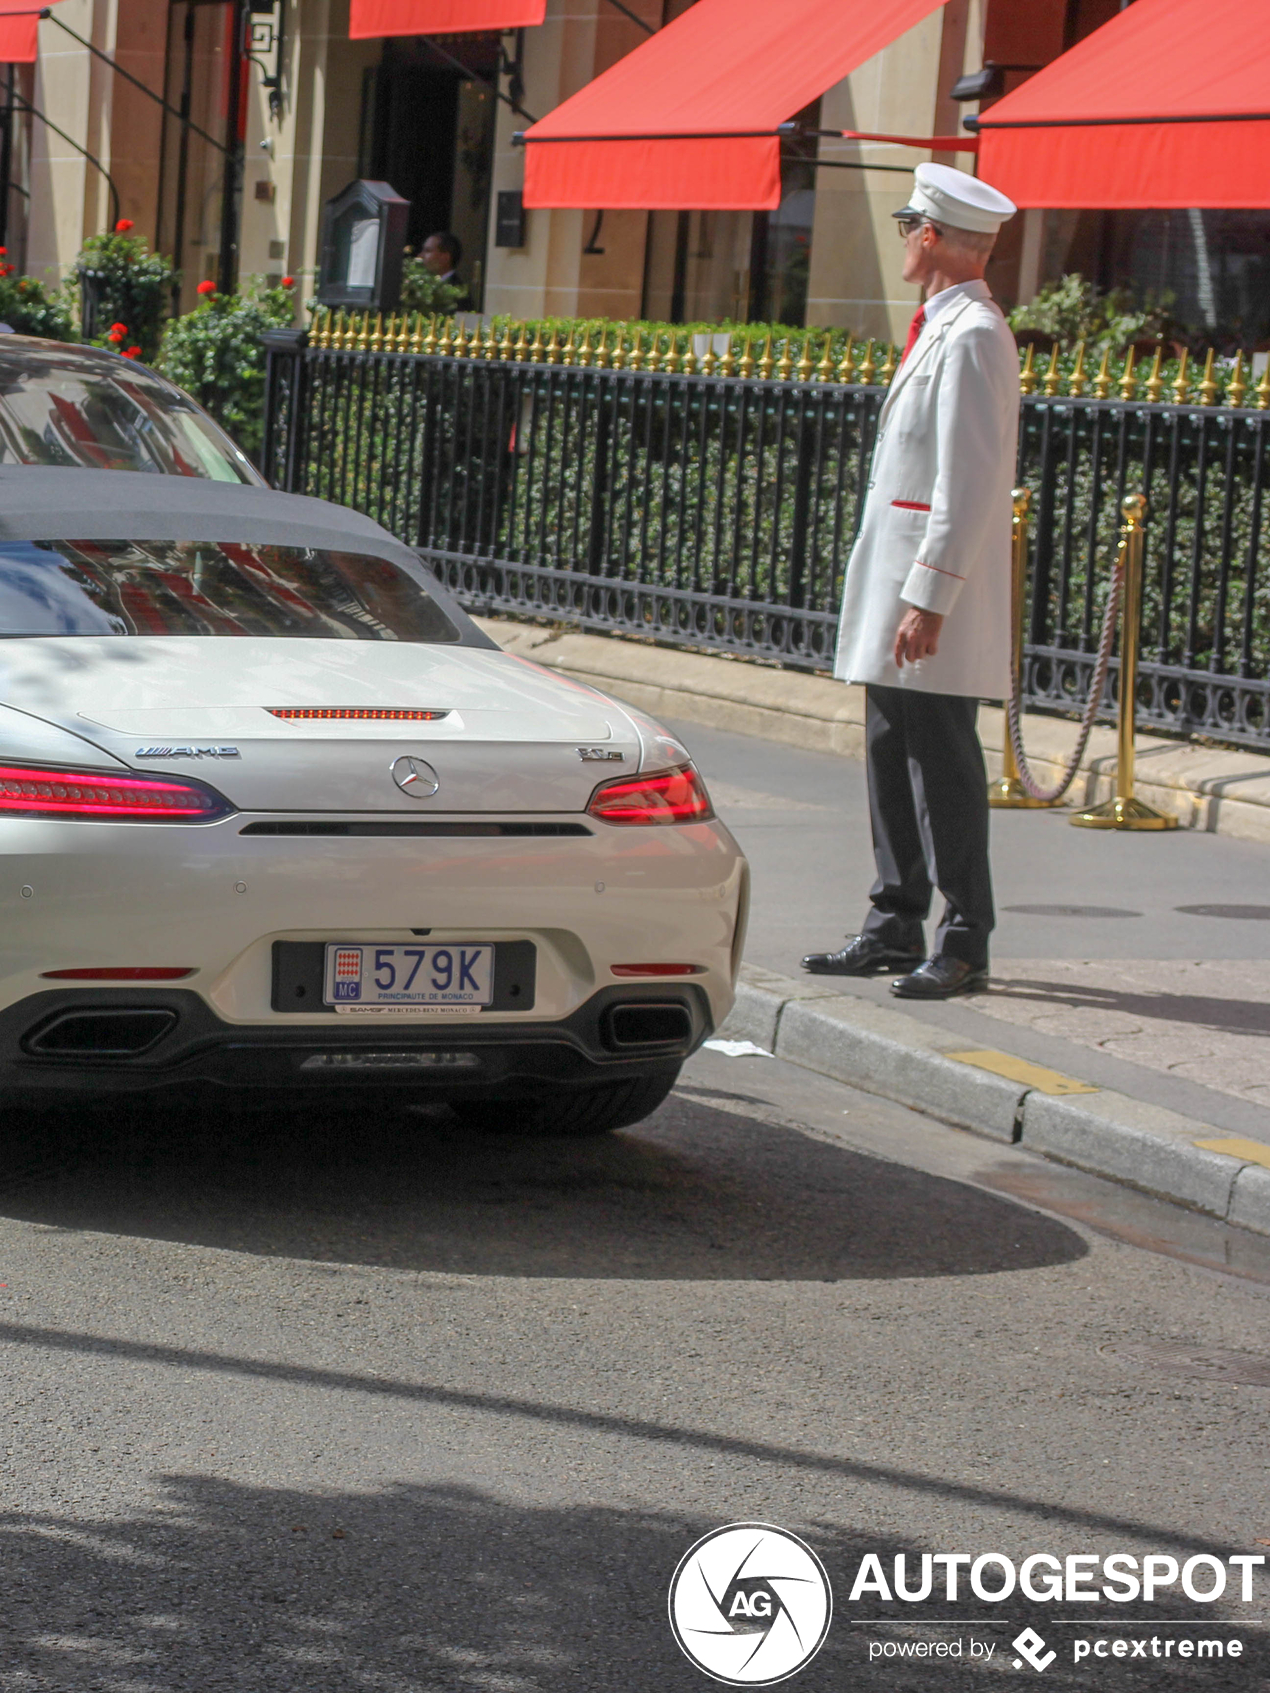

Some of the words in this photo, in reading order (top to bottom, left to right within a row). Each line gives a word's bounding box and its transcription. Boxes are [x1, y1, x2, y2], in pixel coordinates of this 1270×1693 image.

[375, 950, 482, 990] 579K
[339, 983, 357, 997] MC
[378, 993, 426, 1001] PRINCIPAUTE
[429, 992, 439, 1000] DE
[441, 993, 474, 1001] MONACO
